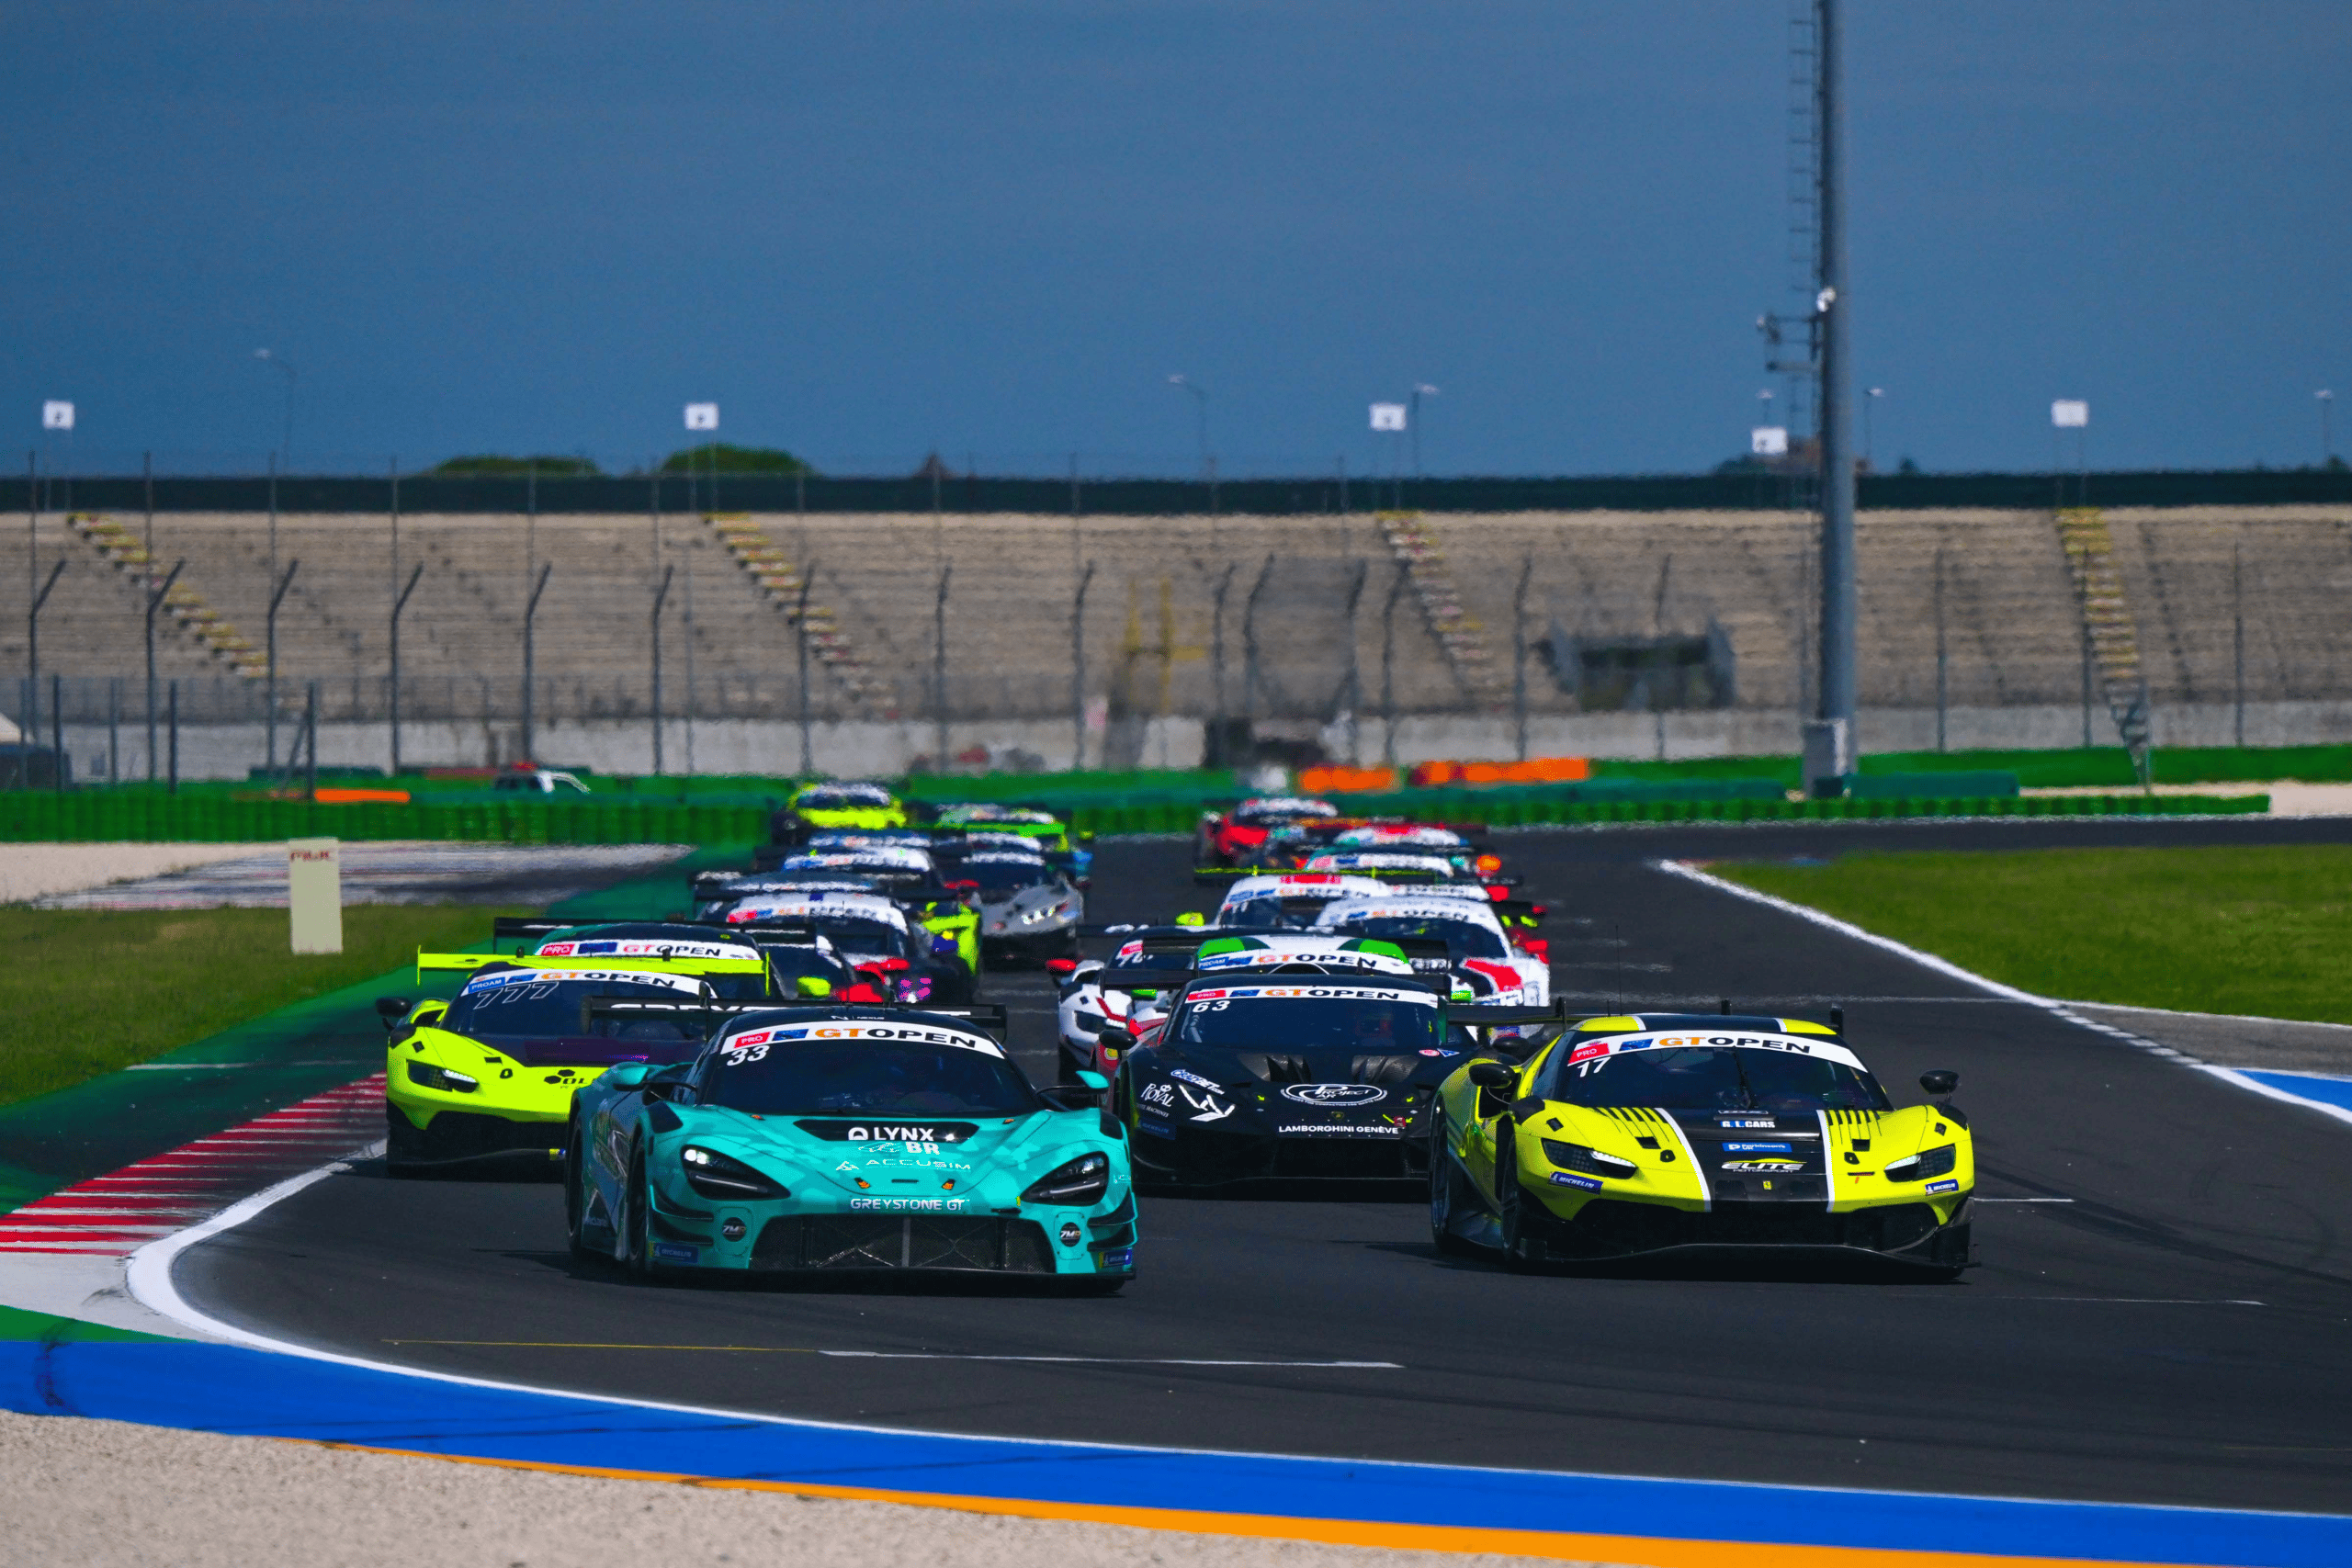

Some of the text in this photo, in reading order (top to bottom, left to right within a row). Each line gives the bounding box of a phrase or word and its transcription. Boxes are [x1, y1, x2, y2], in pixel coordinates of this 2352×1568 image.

[471, 978, 503, 990] PROAM
[473, 981, 560, 1010] 777
[1193, 999, 1231, 1013] 63
[741, 1034, 763, 1045] PRO
[726, 1044, 771, 1066] 33
[1576, 1047, 1598, 1058] PRO
[1577, 1056, 1611, 1077] 17
[1140, 1083, 1175, 1108] ROYAL
[1558, 1176, 1595, 1189] MICHELIN
[850, 1198, 943, 1211] GREYSTONE
